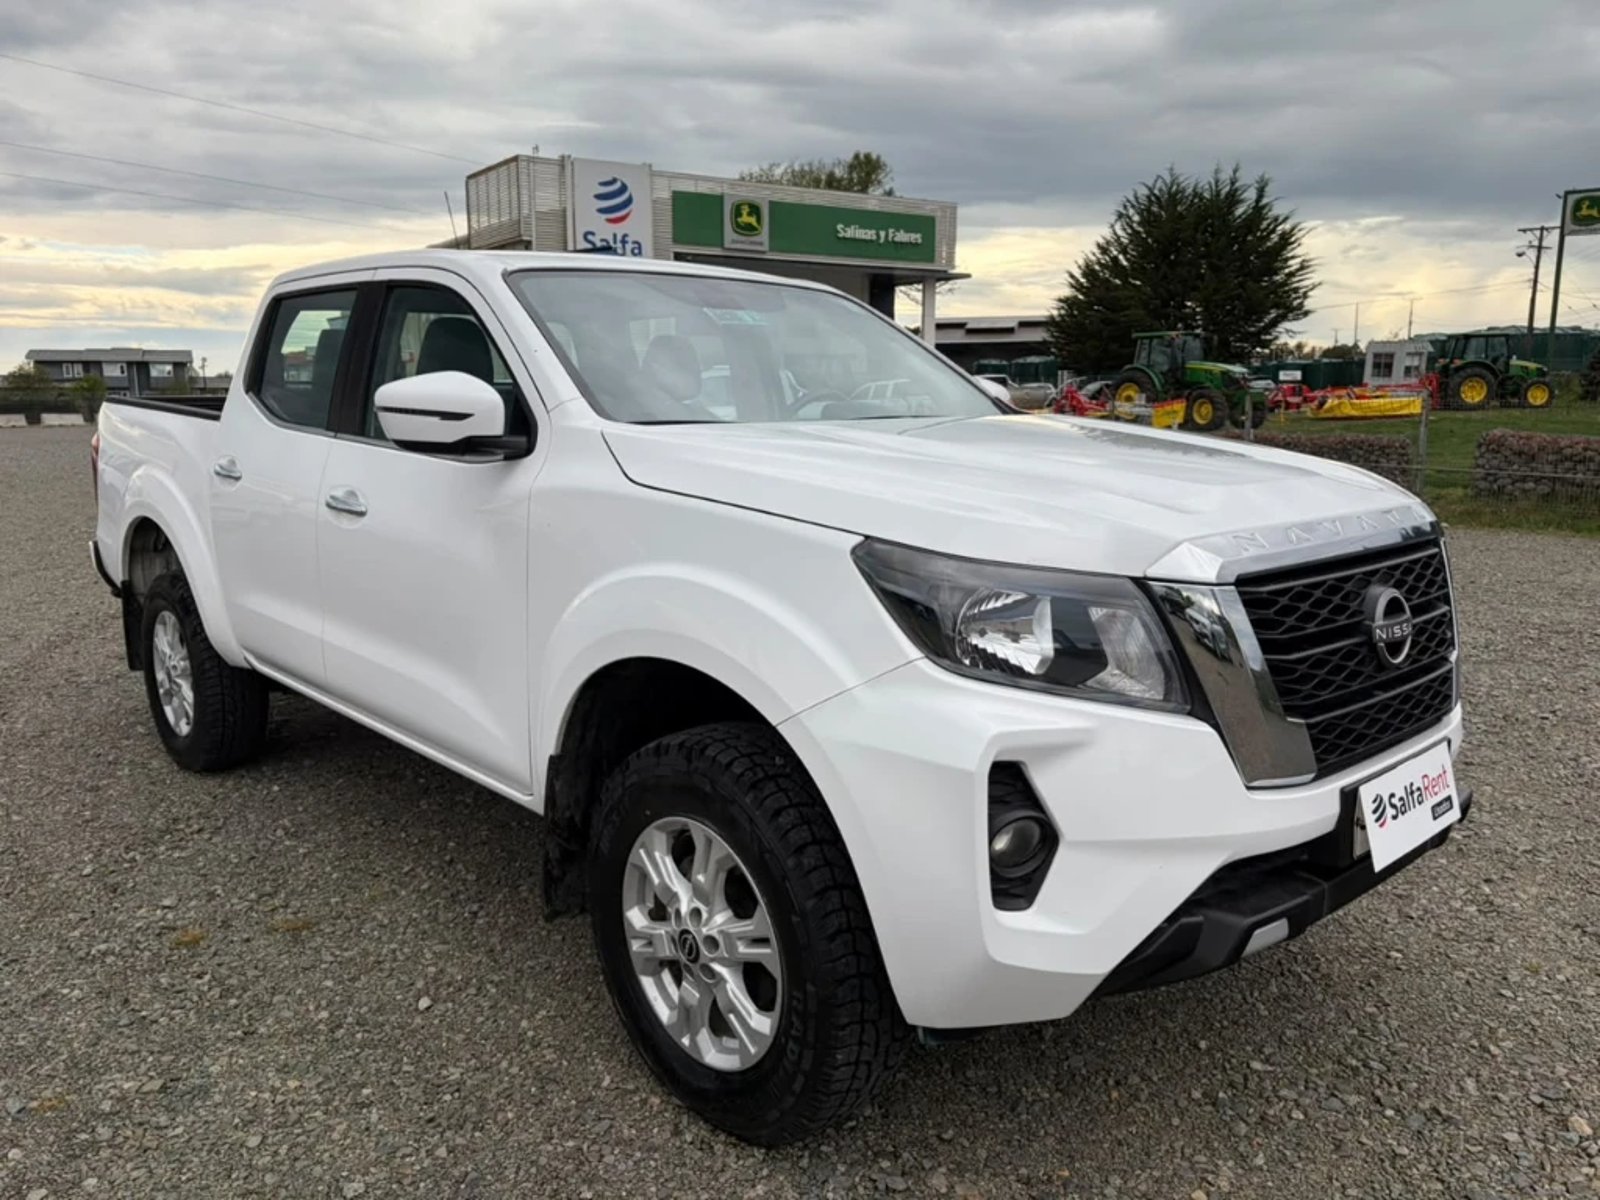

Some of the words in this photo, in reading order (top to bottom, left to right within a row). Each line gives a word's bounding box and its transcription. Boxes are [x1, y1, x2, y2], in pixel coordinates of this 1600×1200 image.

[836, 223, 878, 240] Salinas
[879, 230, 886, 243] y
[1376, 622, 1410, 639] NISS
[1388, 763, 1450, 821] SalfaRent
